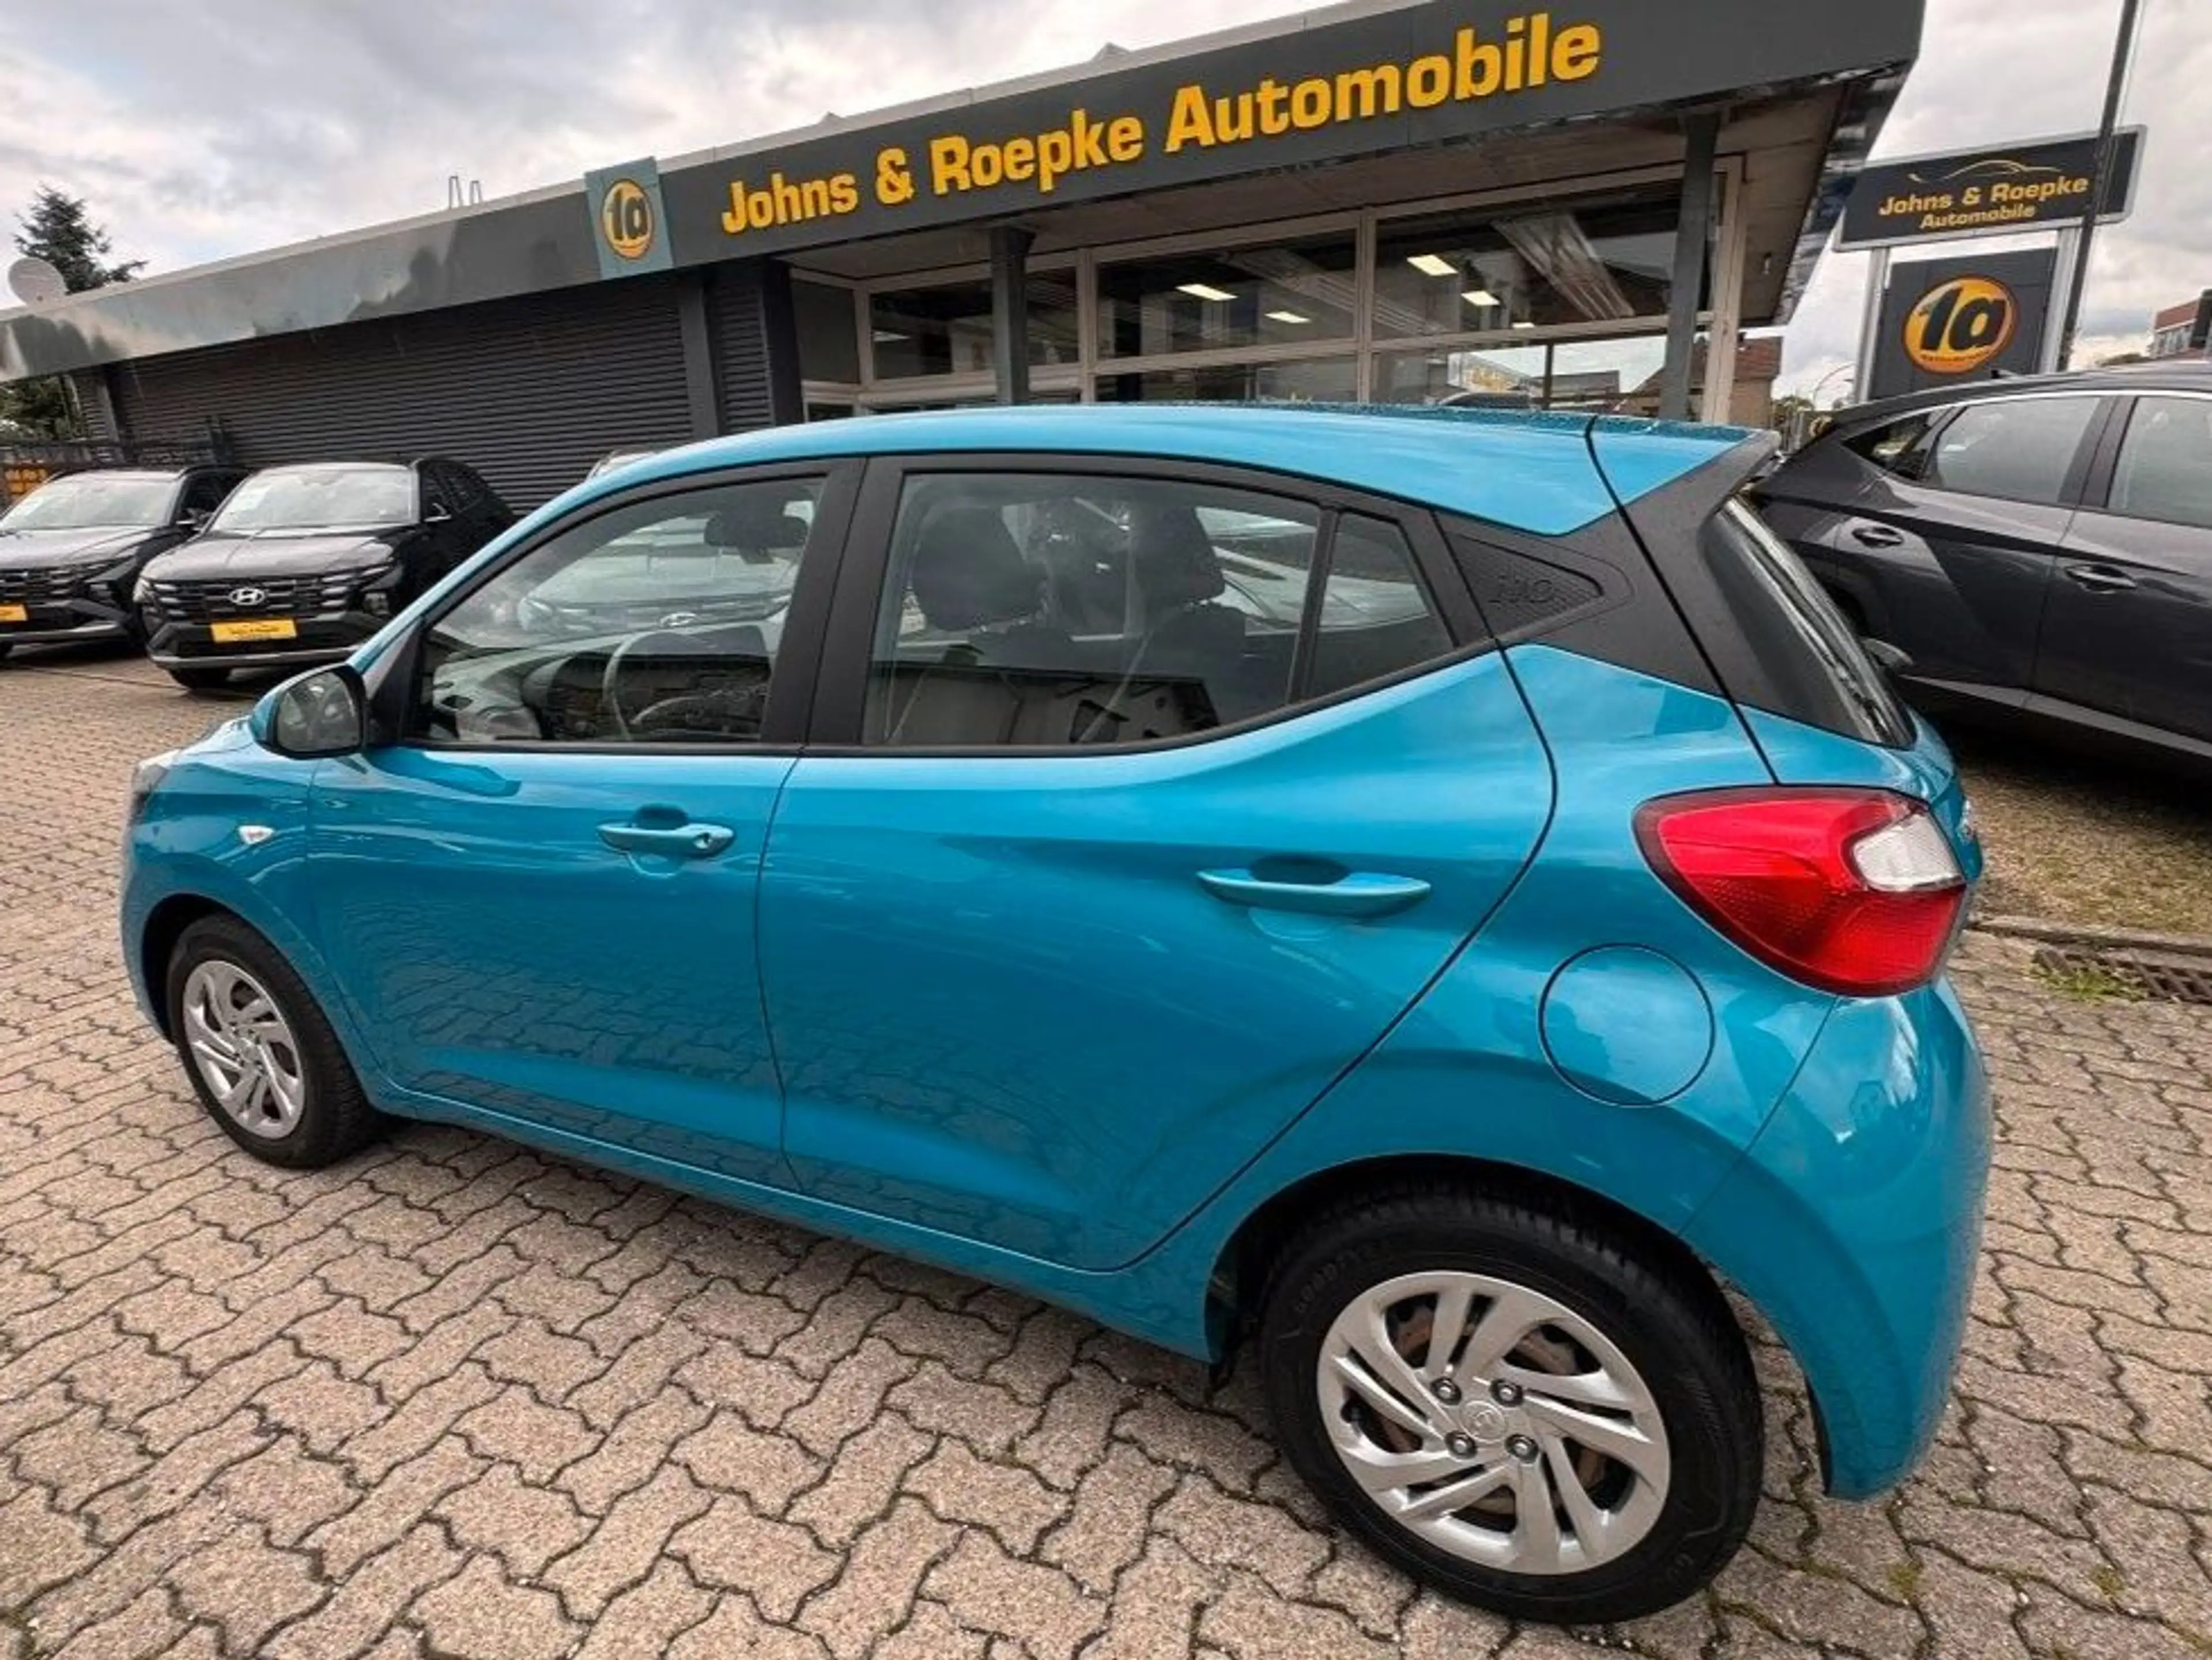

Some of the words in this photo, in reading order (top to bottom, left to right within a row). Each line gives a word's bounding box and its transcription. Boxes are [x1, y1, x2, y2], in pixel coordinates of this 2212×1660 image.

[723, 173, 859, 234] Johns
[875, 147, 915, 205] &
[930, 109, 1143, 195] Roepke
[1165, 12, 1601, 153] Automobile
[1878, 194, 1953, 216] Johns
[1961, 187, 1981, 206] &
[1991, 175, 2089, 202] Roepke
[1919, 203, 2036, 229] Automobile
[1917, 286, 2006, 350] 1a
